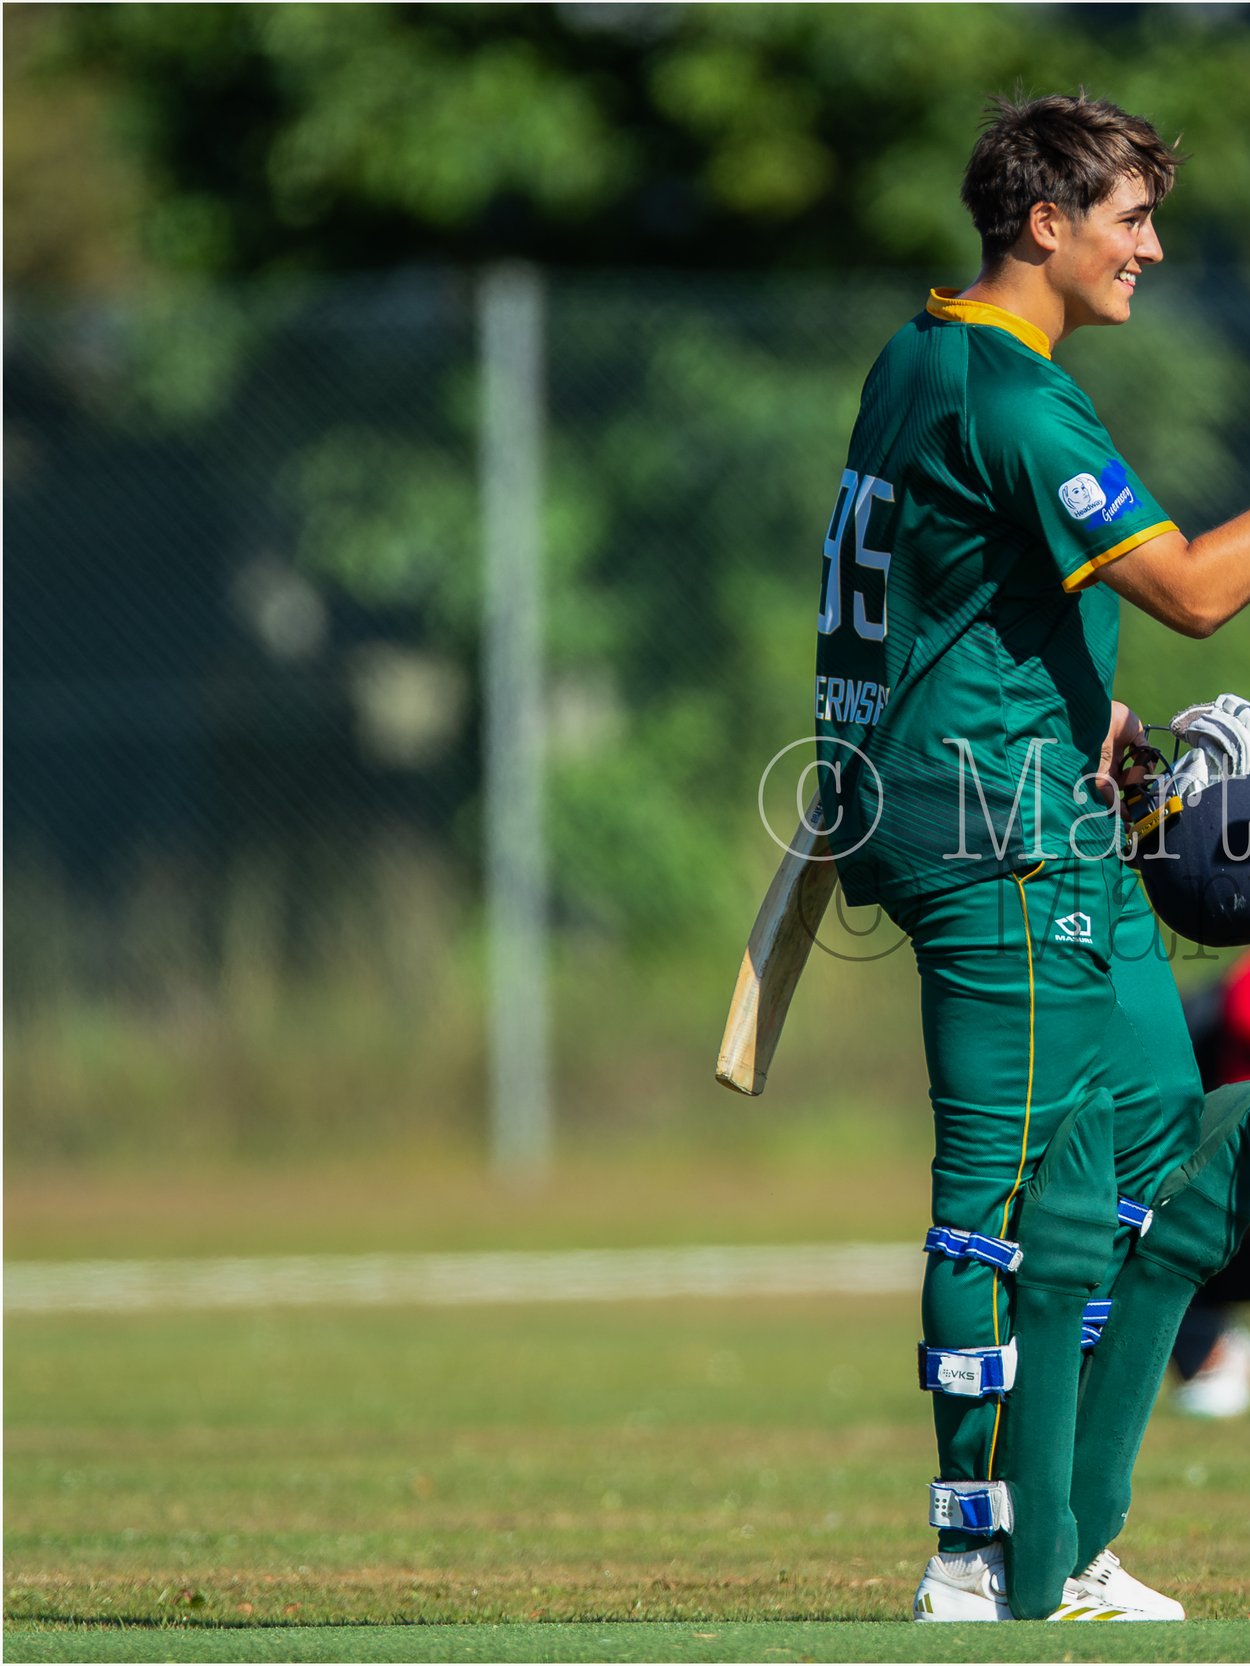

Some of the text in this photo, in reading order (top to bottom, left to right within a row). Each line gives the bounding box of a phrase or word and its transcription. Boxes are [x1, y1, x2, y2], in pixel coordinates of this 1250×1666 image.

[1073, 499, 1104, 518] Headway
[1101, 486, 1135, 522] Guernsey
[1055, 934, 1094, 944] MASURI
[951, 1369, 975, 1381] VKS
